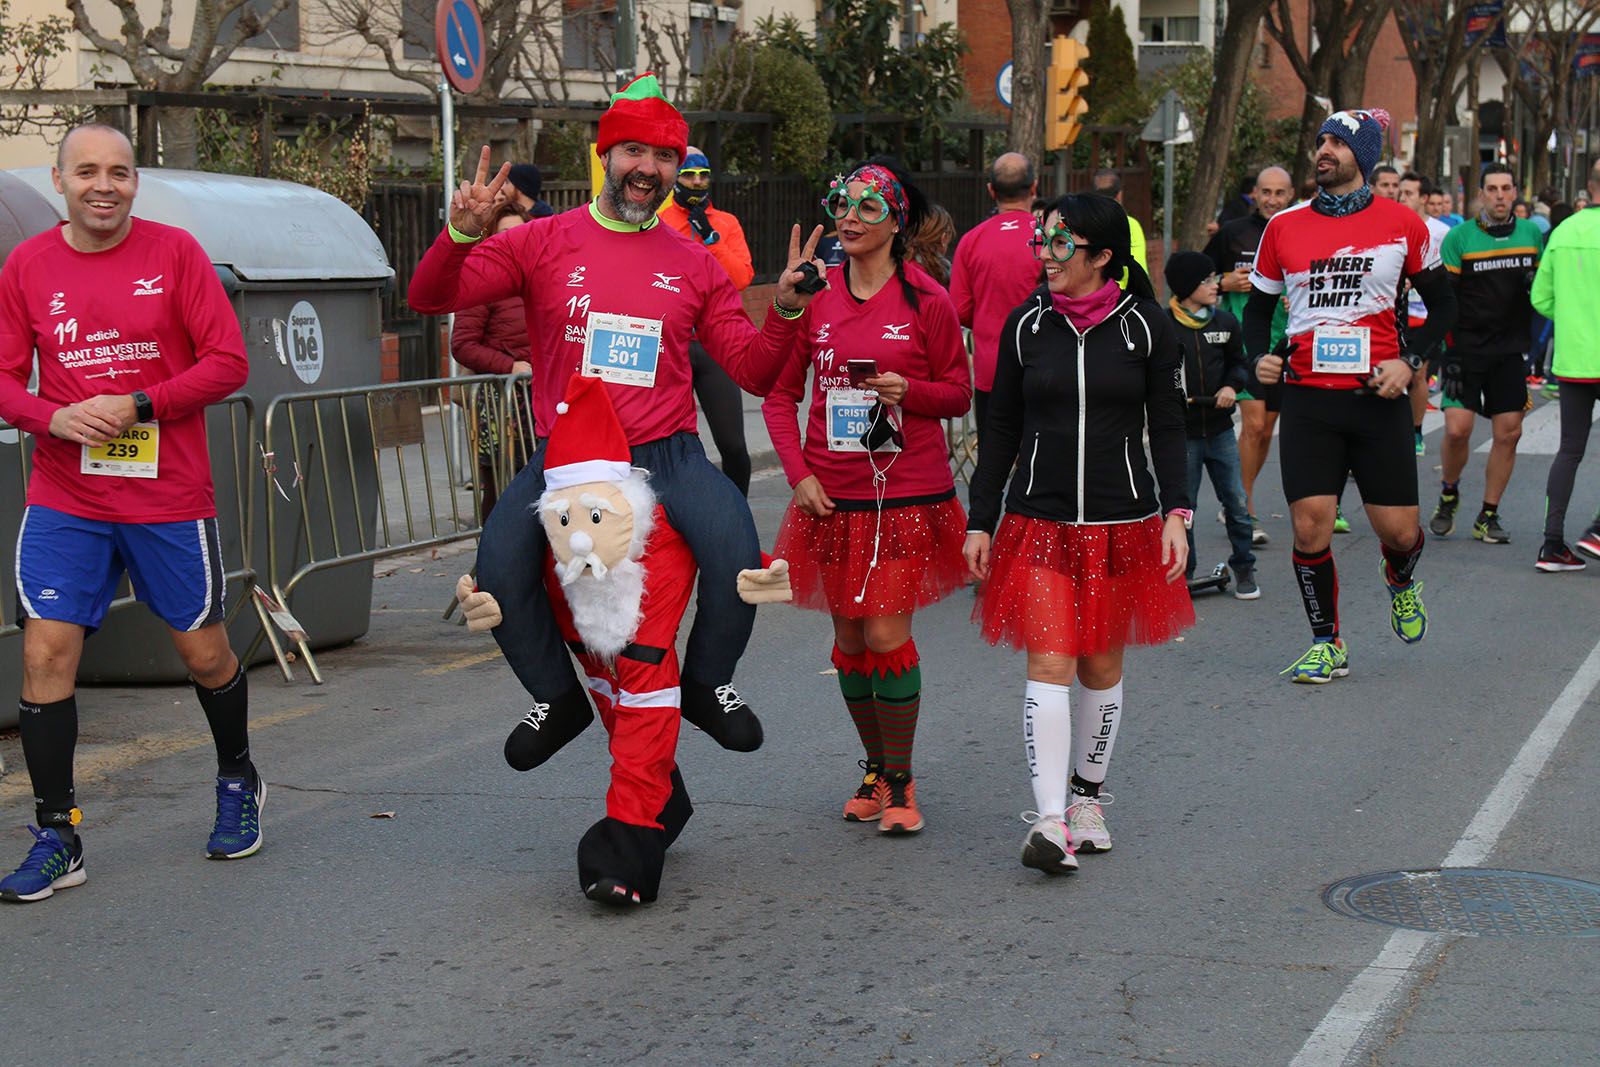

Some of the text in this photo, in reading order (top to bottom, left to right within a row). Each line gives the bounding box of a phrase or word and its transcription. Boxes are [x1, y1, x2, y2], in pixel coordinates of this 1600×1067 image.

[1310, 257, 1374, 274] WHERE
[1473, 257, 1520, 272] CERDANYOLA
[1310, 274, 1362, 291] IS THE
[566, 294, 591, 318] 19
[1308, 291, 1362, 308] LIMIT?
[54, 318, 119, 345] 19 edició
[565, 325, 587, 336] SAN
[293, 328, 318, 362] bé
[608, 334, 640, 349] JAVI
[1321, 343, 1357, 357] 1973
[58, 342, 157, 362] SANT SILVESTRE
[608, 349, 638, 366] 501
[817, 348, 834, 370] 19
[837, 408, 868, 418] CRISTI
[107, 443, 138, 458] 239
